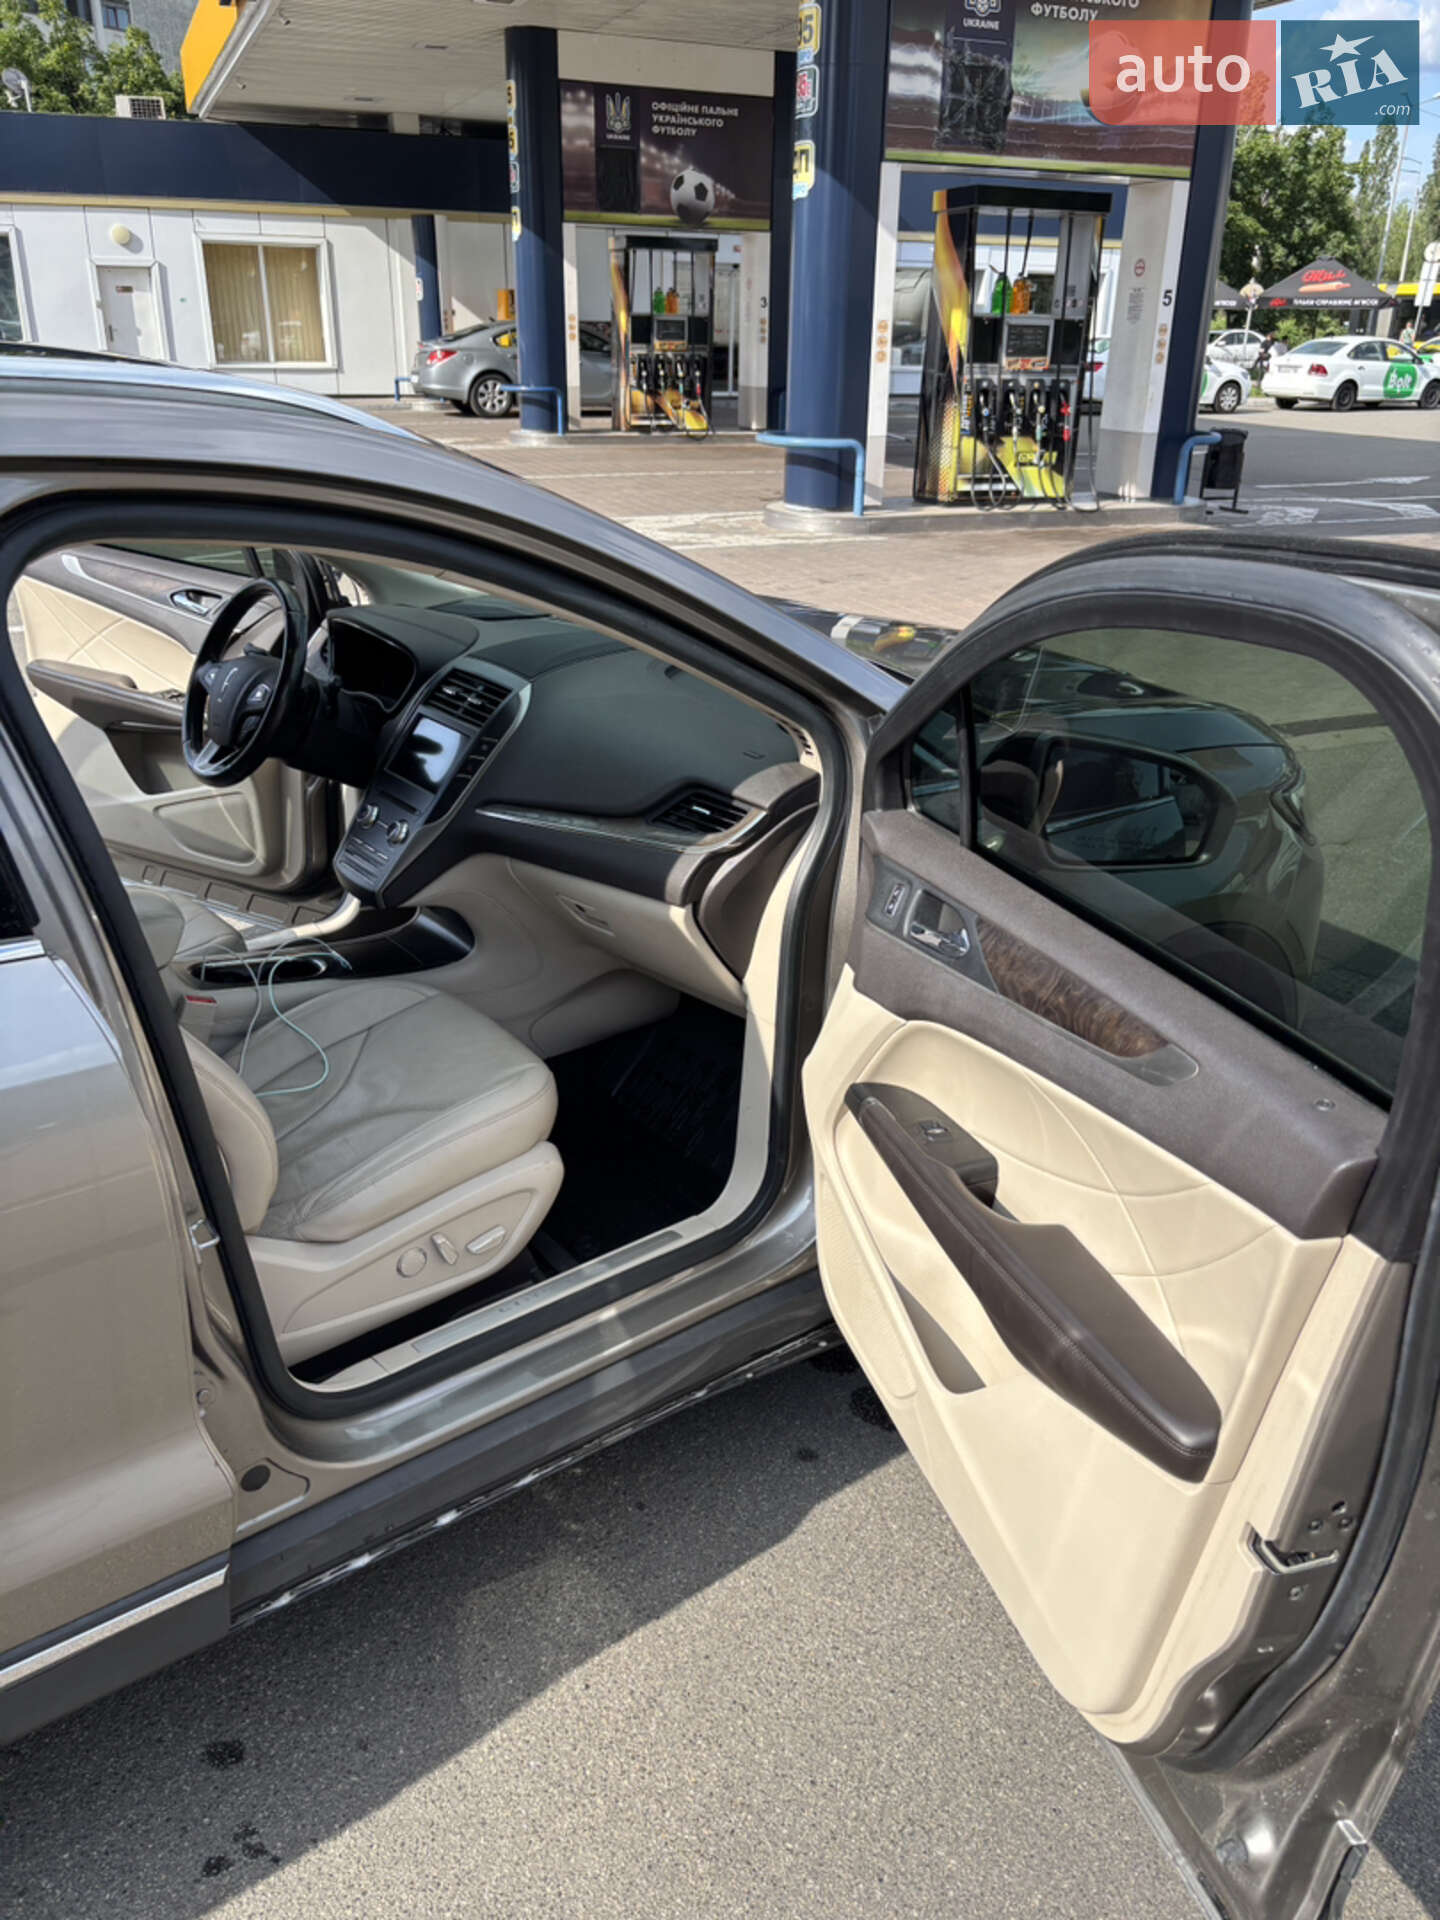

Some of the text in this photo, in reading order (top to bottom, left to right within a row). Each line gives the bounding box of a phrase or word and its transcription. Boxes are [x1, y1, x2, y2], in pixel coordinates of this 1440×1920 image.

[1030, 3, 1099, 21] ФУТБОЛУ
[962, 18, 1000, 30] UKRAINE
[651, 101, 739, 116] ОФІЦІЙНЕ ПАЛЬНЕ
[652, 113, 724, 128] УКРАЇНСЬКОГО
[652, 125, 697, 136] ФУТБОЛУ
[760, 296, 768, 309] 3
[1162, 290, 1173, 307] 5
[1388, 368, 1413, 392] Bolt
